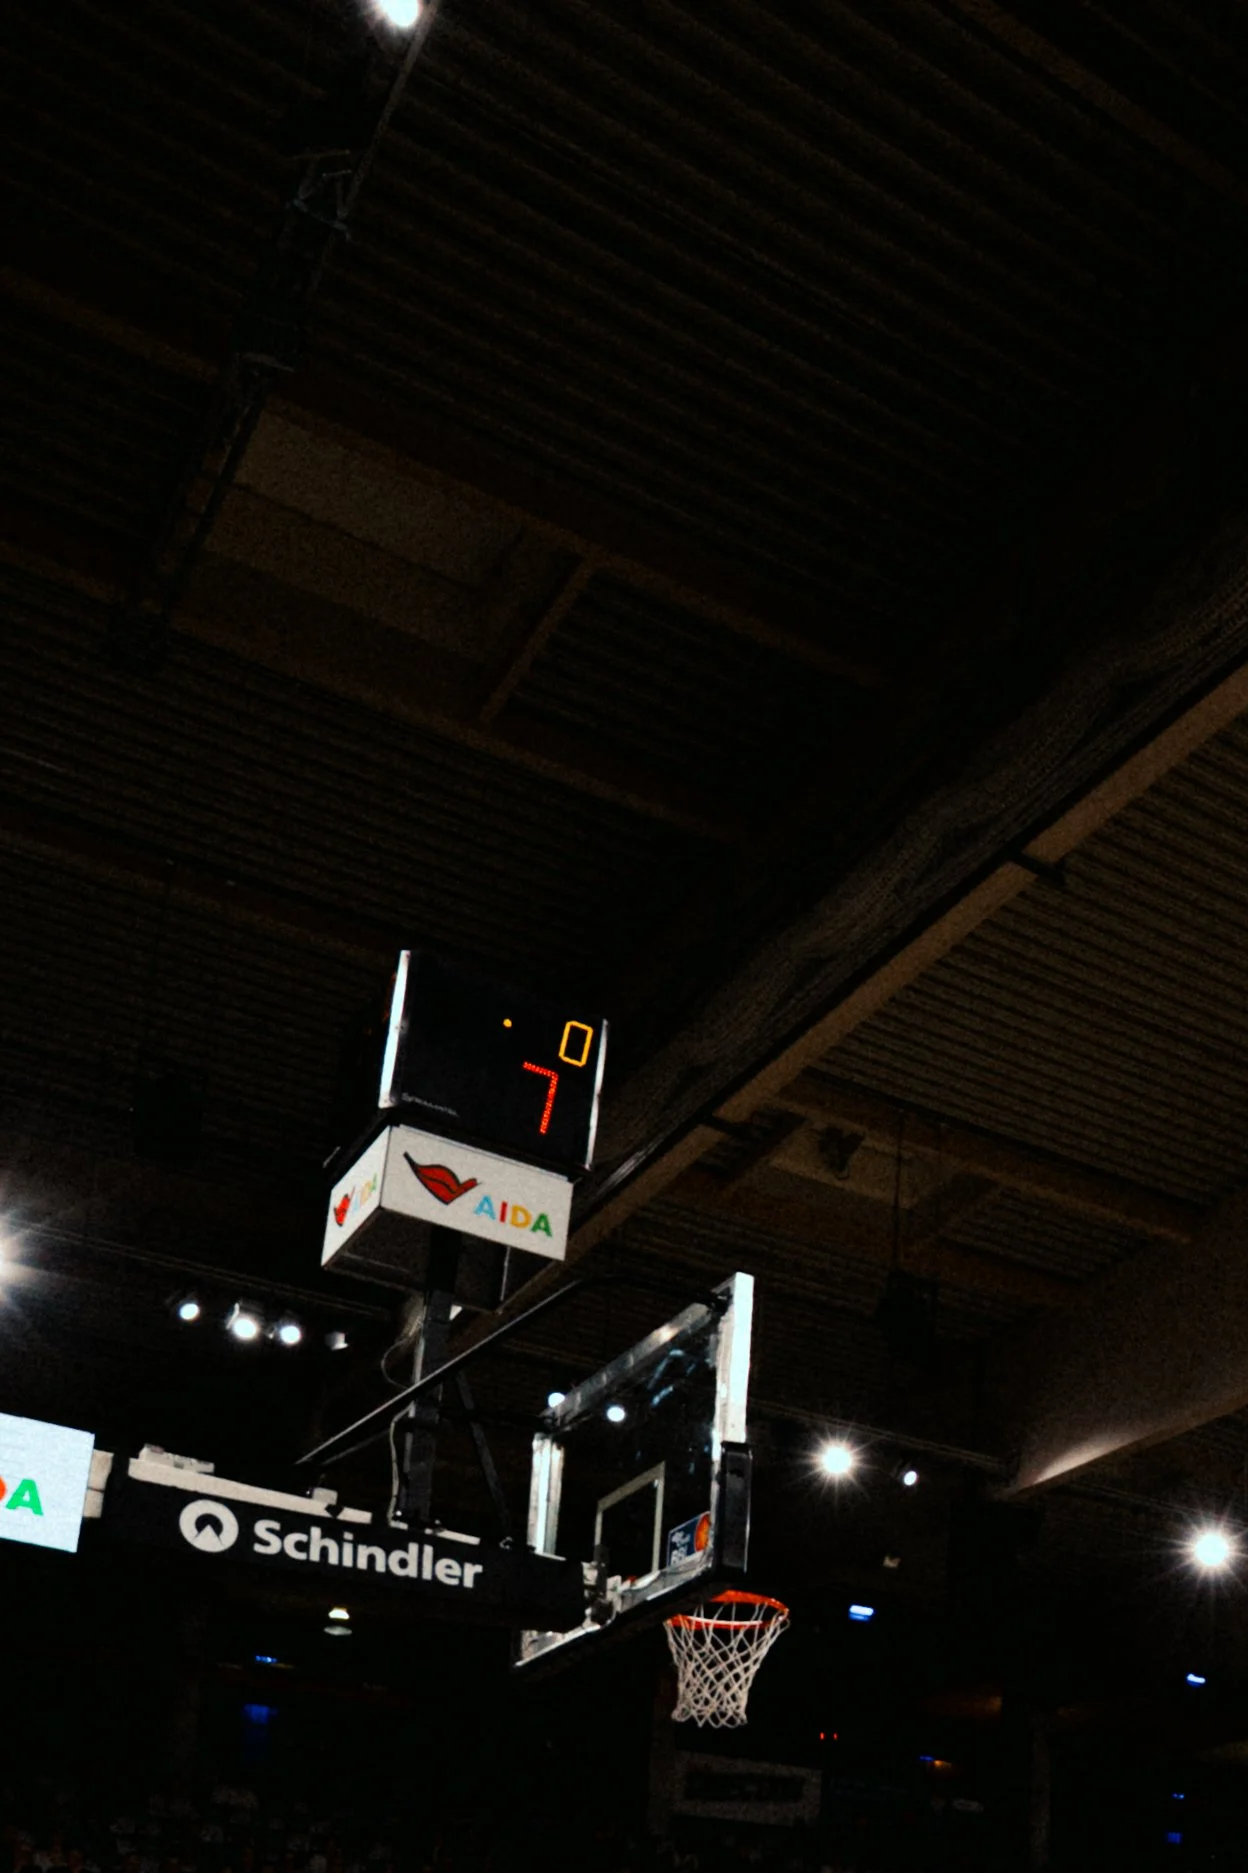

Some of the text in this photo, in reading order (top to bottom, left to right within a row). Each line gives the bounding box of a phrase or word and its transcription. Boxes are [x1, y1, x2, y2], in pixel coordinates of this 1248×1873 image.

[559, 1020, 594, 1067] 0
[523, 1061, 559, 1135] 7
[474, 1195, 553, 1238] AIDA
[253, 1519, 484, 1589] Schindler
